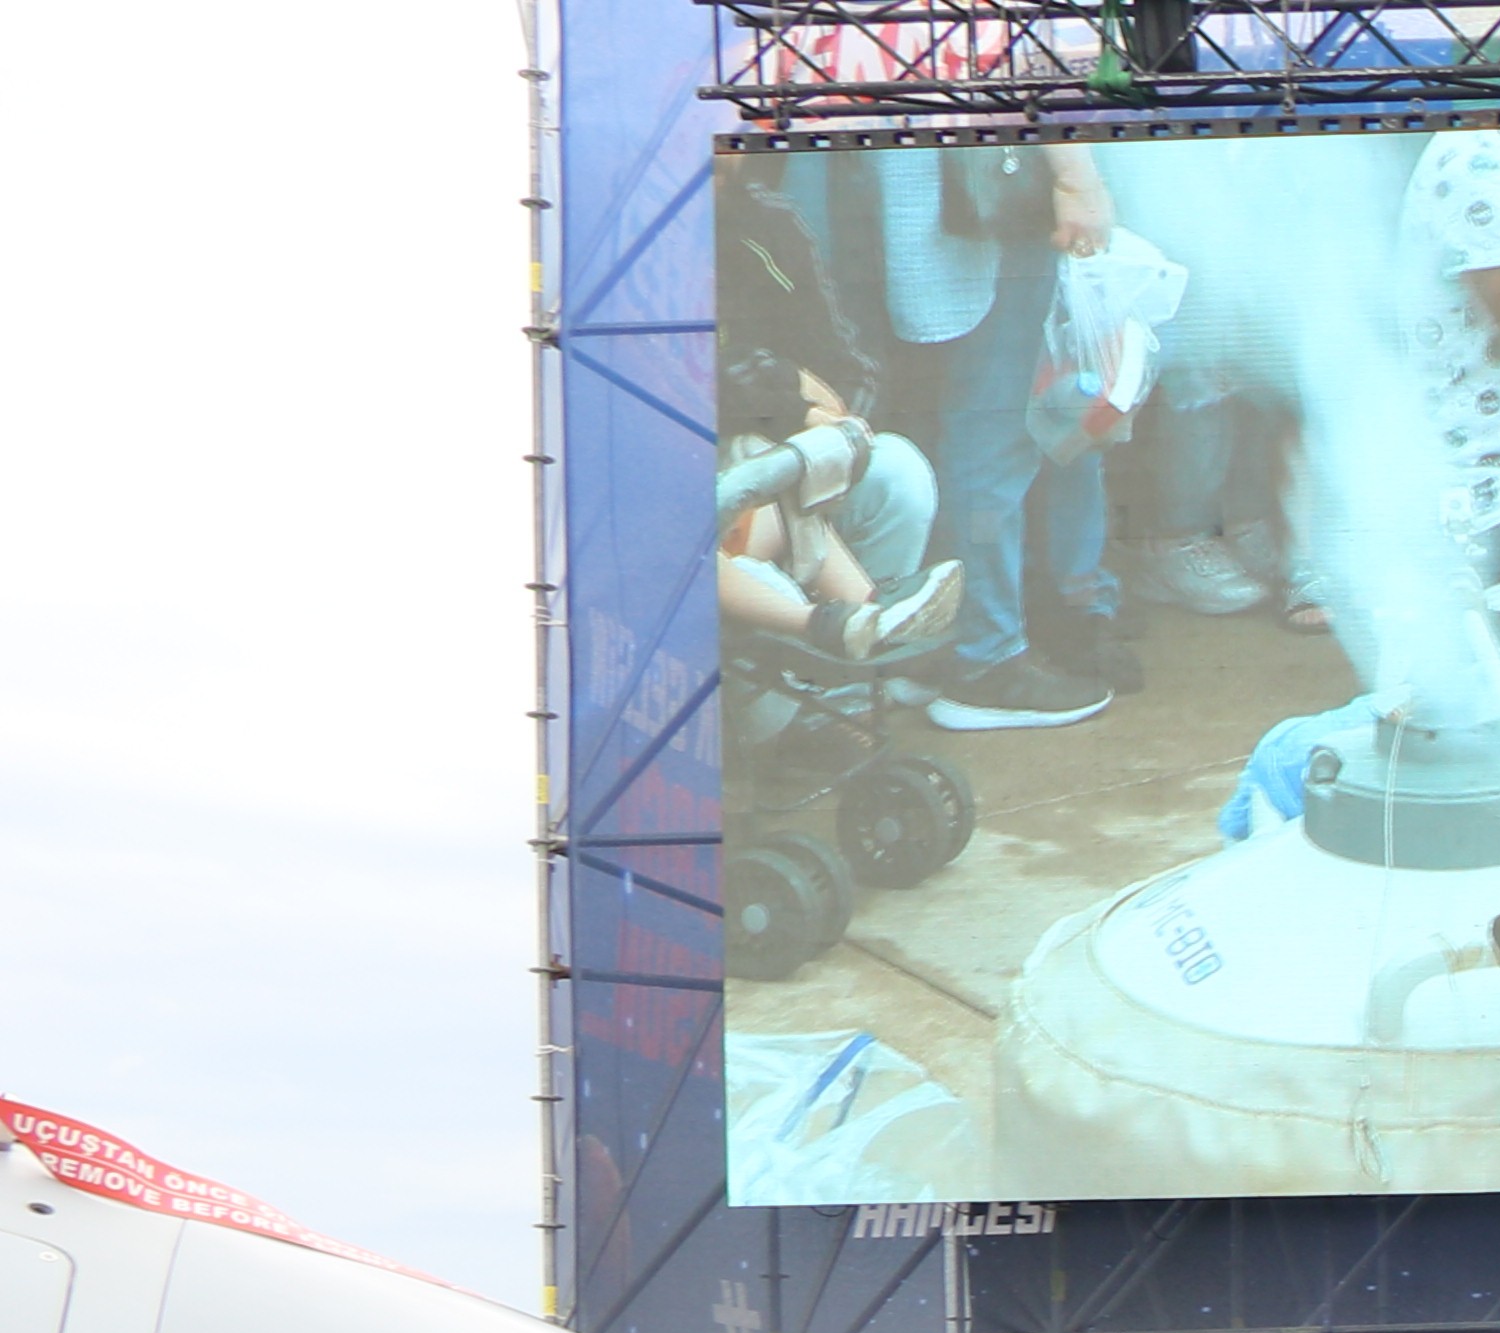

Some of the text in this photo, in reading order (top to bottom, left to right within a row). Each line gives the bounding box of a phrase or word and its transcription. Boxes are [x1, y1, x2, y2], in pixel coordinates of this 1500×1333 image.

[12, 1113, 248, 1207] UÇUŞTAN ÖNCE
[39, 1152, 161, 1206] REMOVE
[171, 1197, 289, 1236] BEFORE
